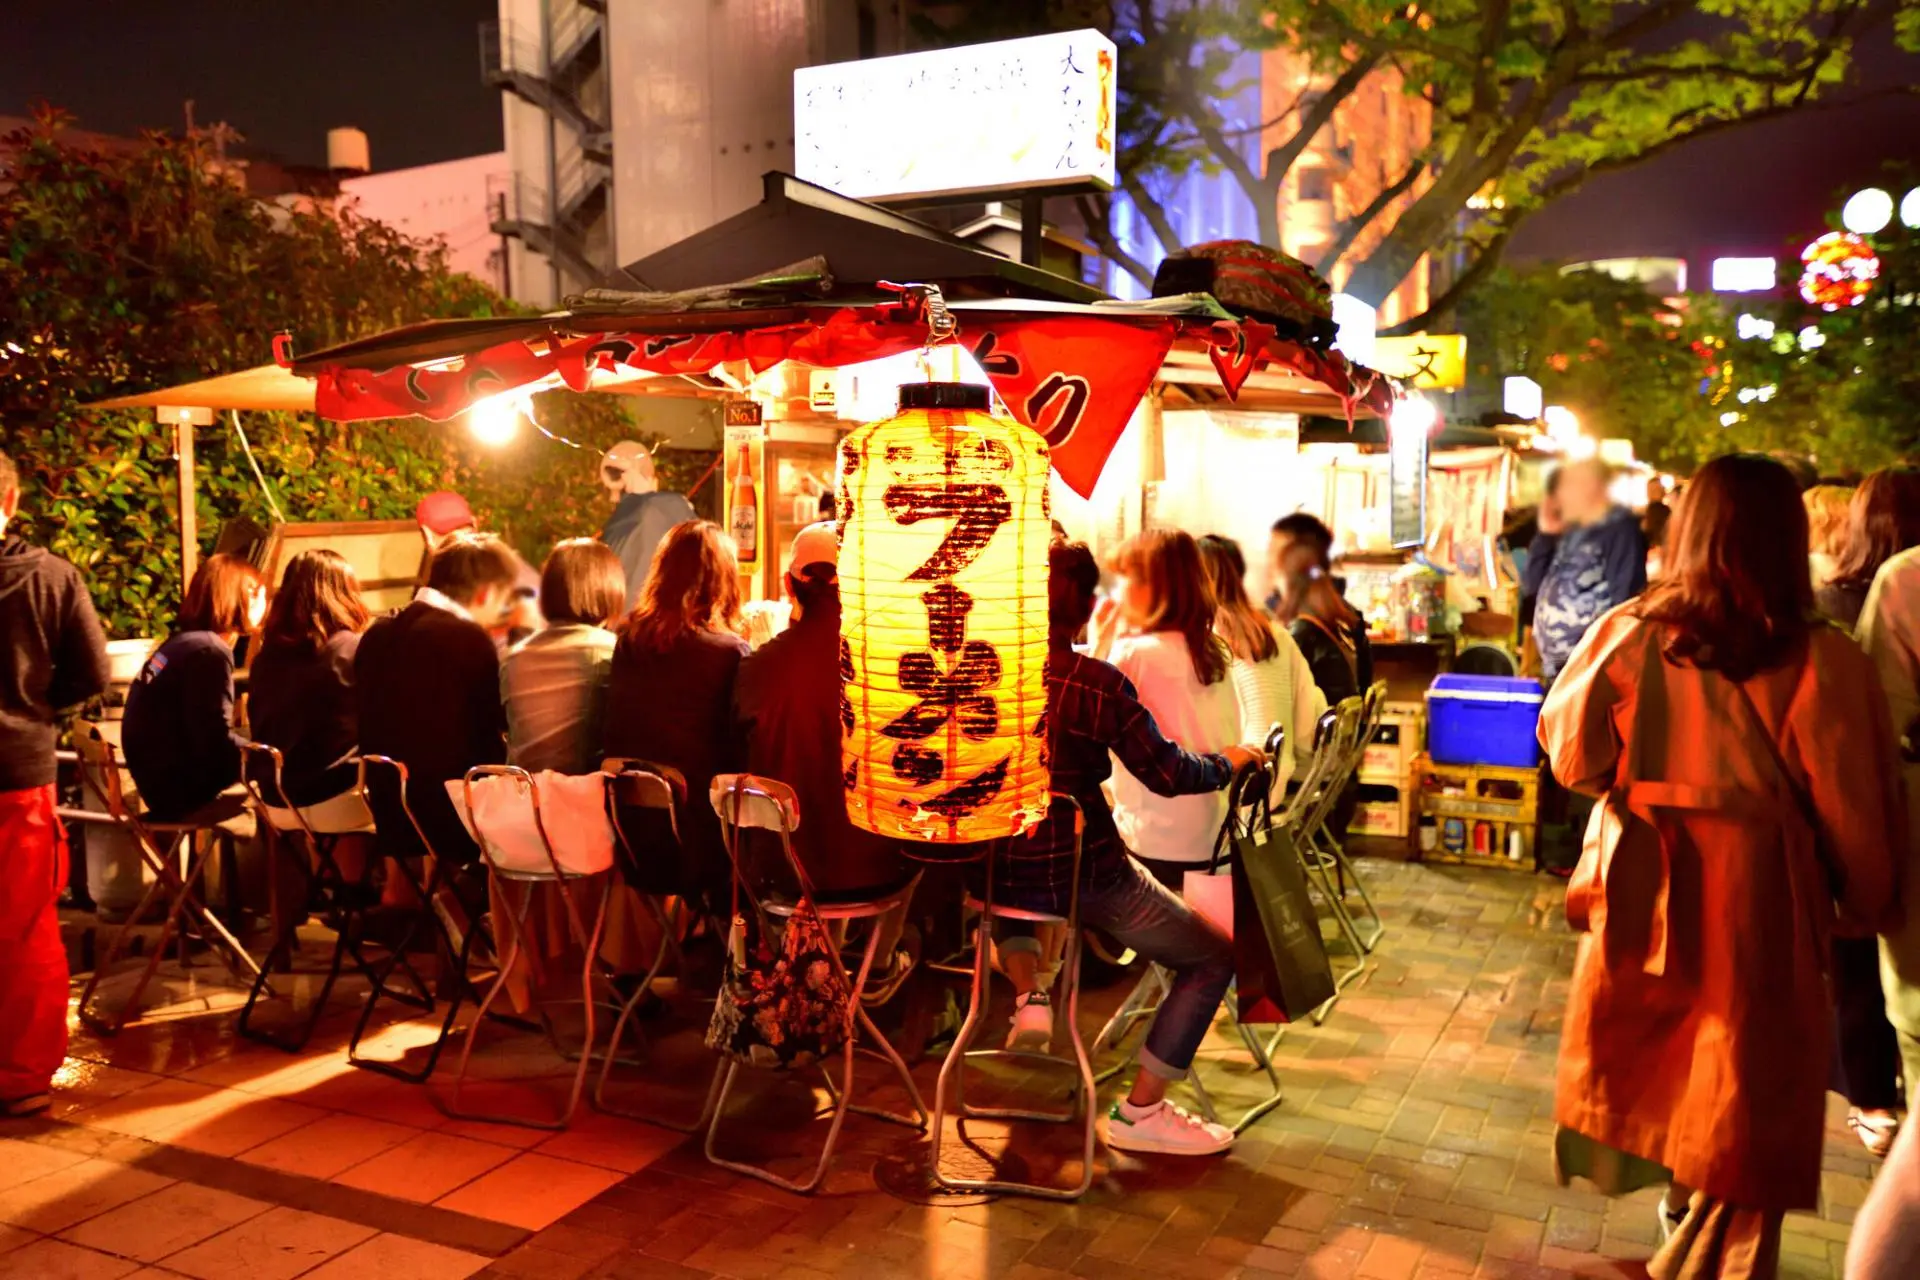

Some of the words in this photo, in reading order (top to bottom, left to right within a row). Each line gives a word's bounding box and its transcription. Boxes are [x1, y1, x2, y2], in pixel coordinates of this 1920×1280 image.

[728, 408, 758, 423] No.1
[880, 439, 1013, 818] ラーメン
